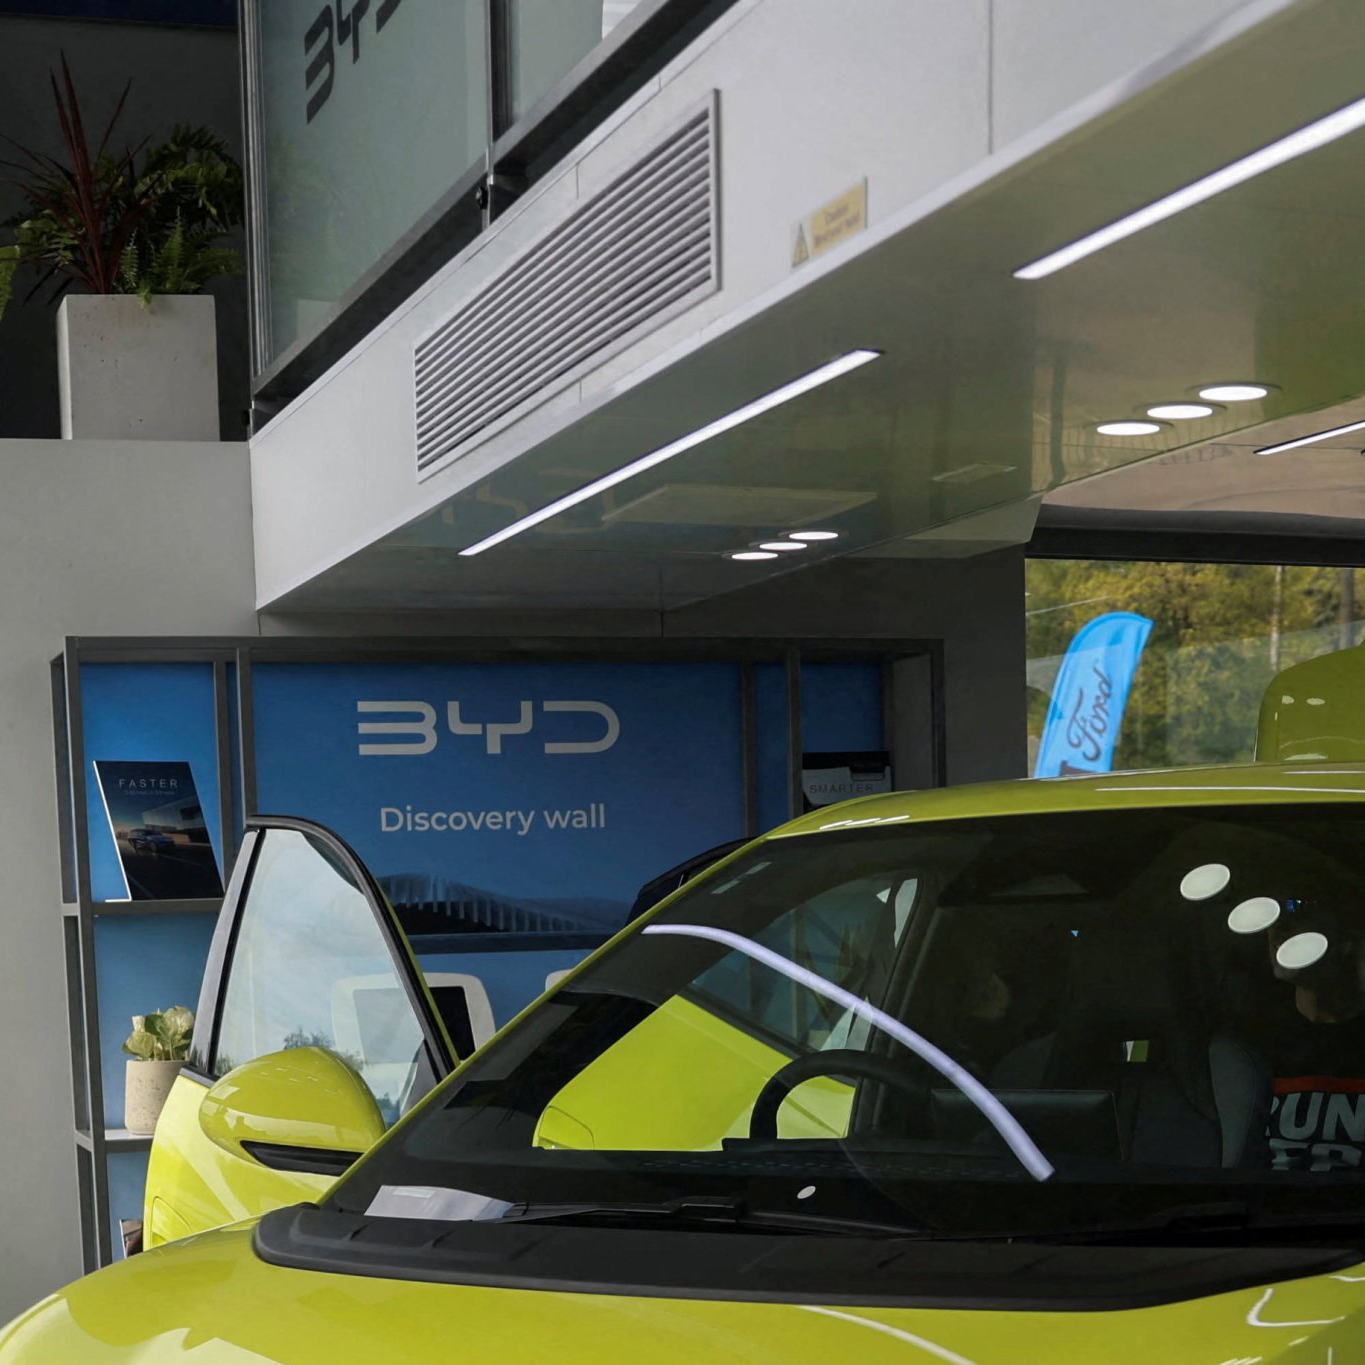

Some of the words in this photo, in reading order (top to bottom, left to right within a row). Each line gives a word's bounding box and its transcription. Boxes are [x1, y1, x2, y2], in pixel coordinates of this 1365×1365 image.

[304, 0, 402, 125] BY
[357, 700, 621, 757] BYD
[1066, 666, 1113, 762] Ford
[118, 778, 179, 789] FASTER
[809, 783, 875, 794] SMARTER
[380, 805, 536, 839] Discovery
[543, 801, 607, 830] wall
